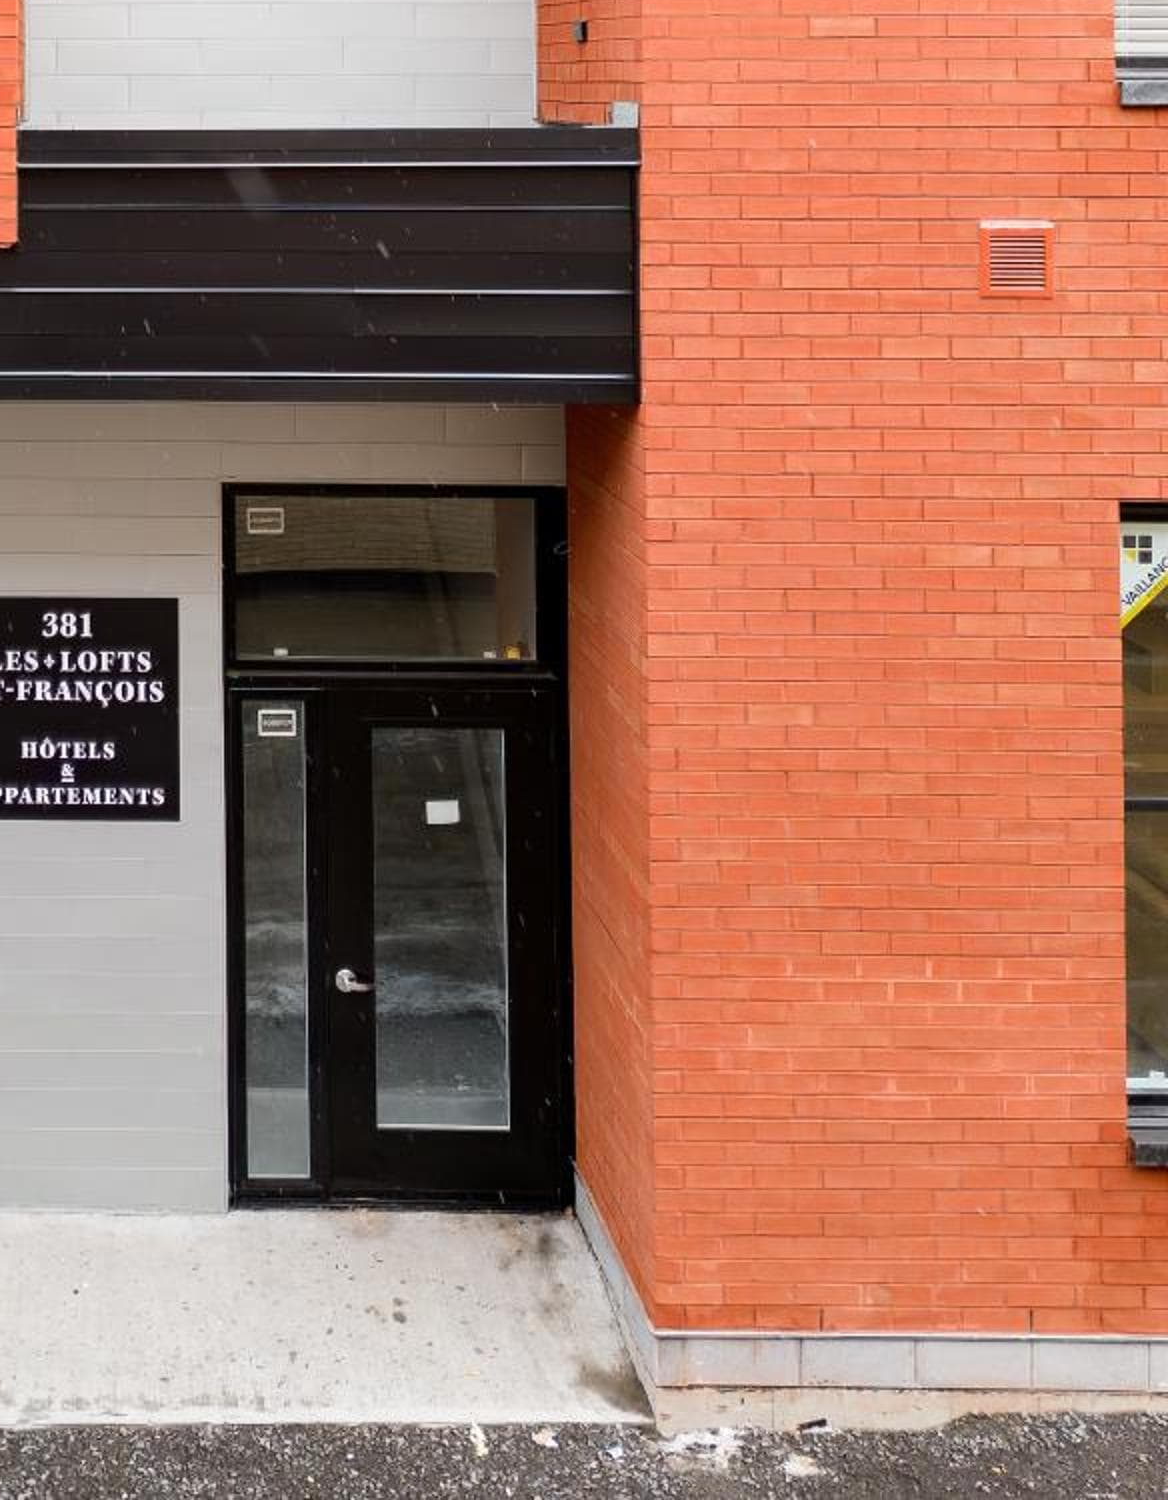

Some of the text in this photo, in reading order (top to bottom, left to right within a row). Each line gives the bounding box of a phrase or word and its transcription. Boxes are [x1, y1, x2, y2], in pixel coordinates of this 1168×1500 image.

[41, 612, 94, 638] 381
[59, 650, 153, 673] LOFTS
[20, 736, 116, 760] HÔTELS
[60, 763, 75, 779] &
